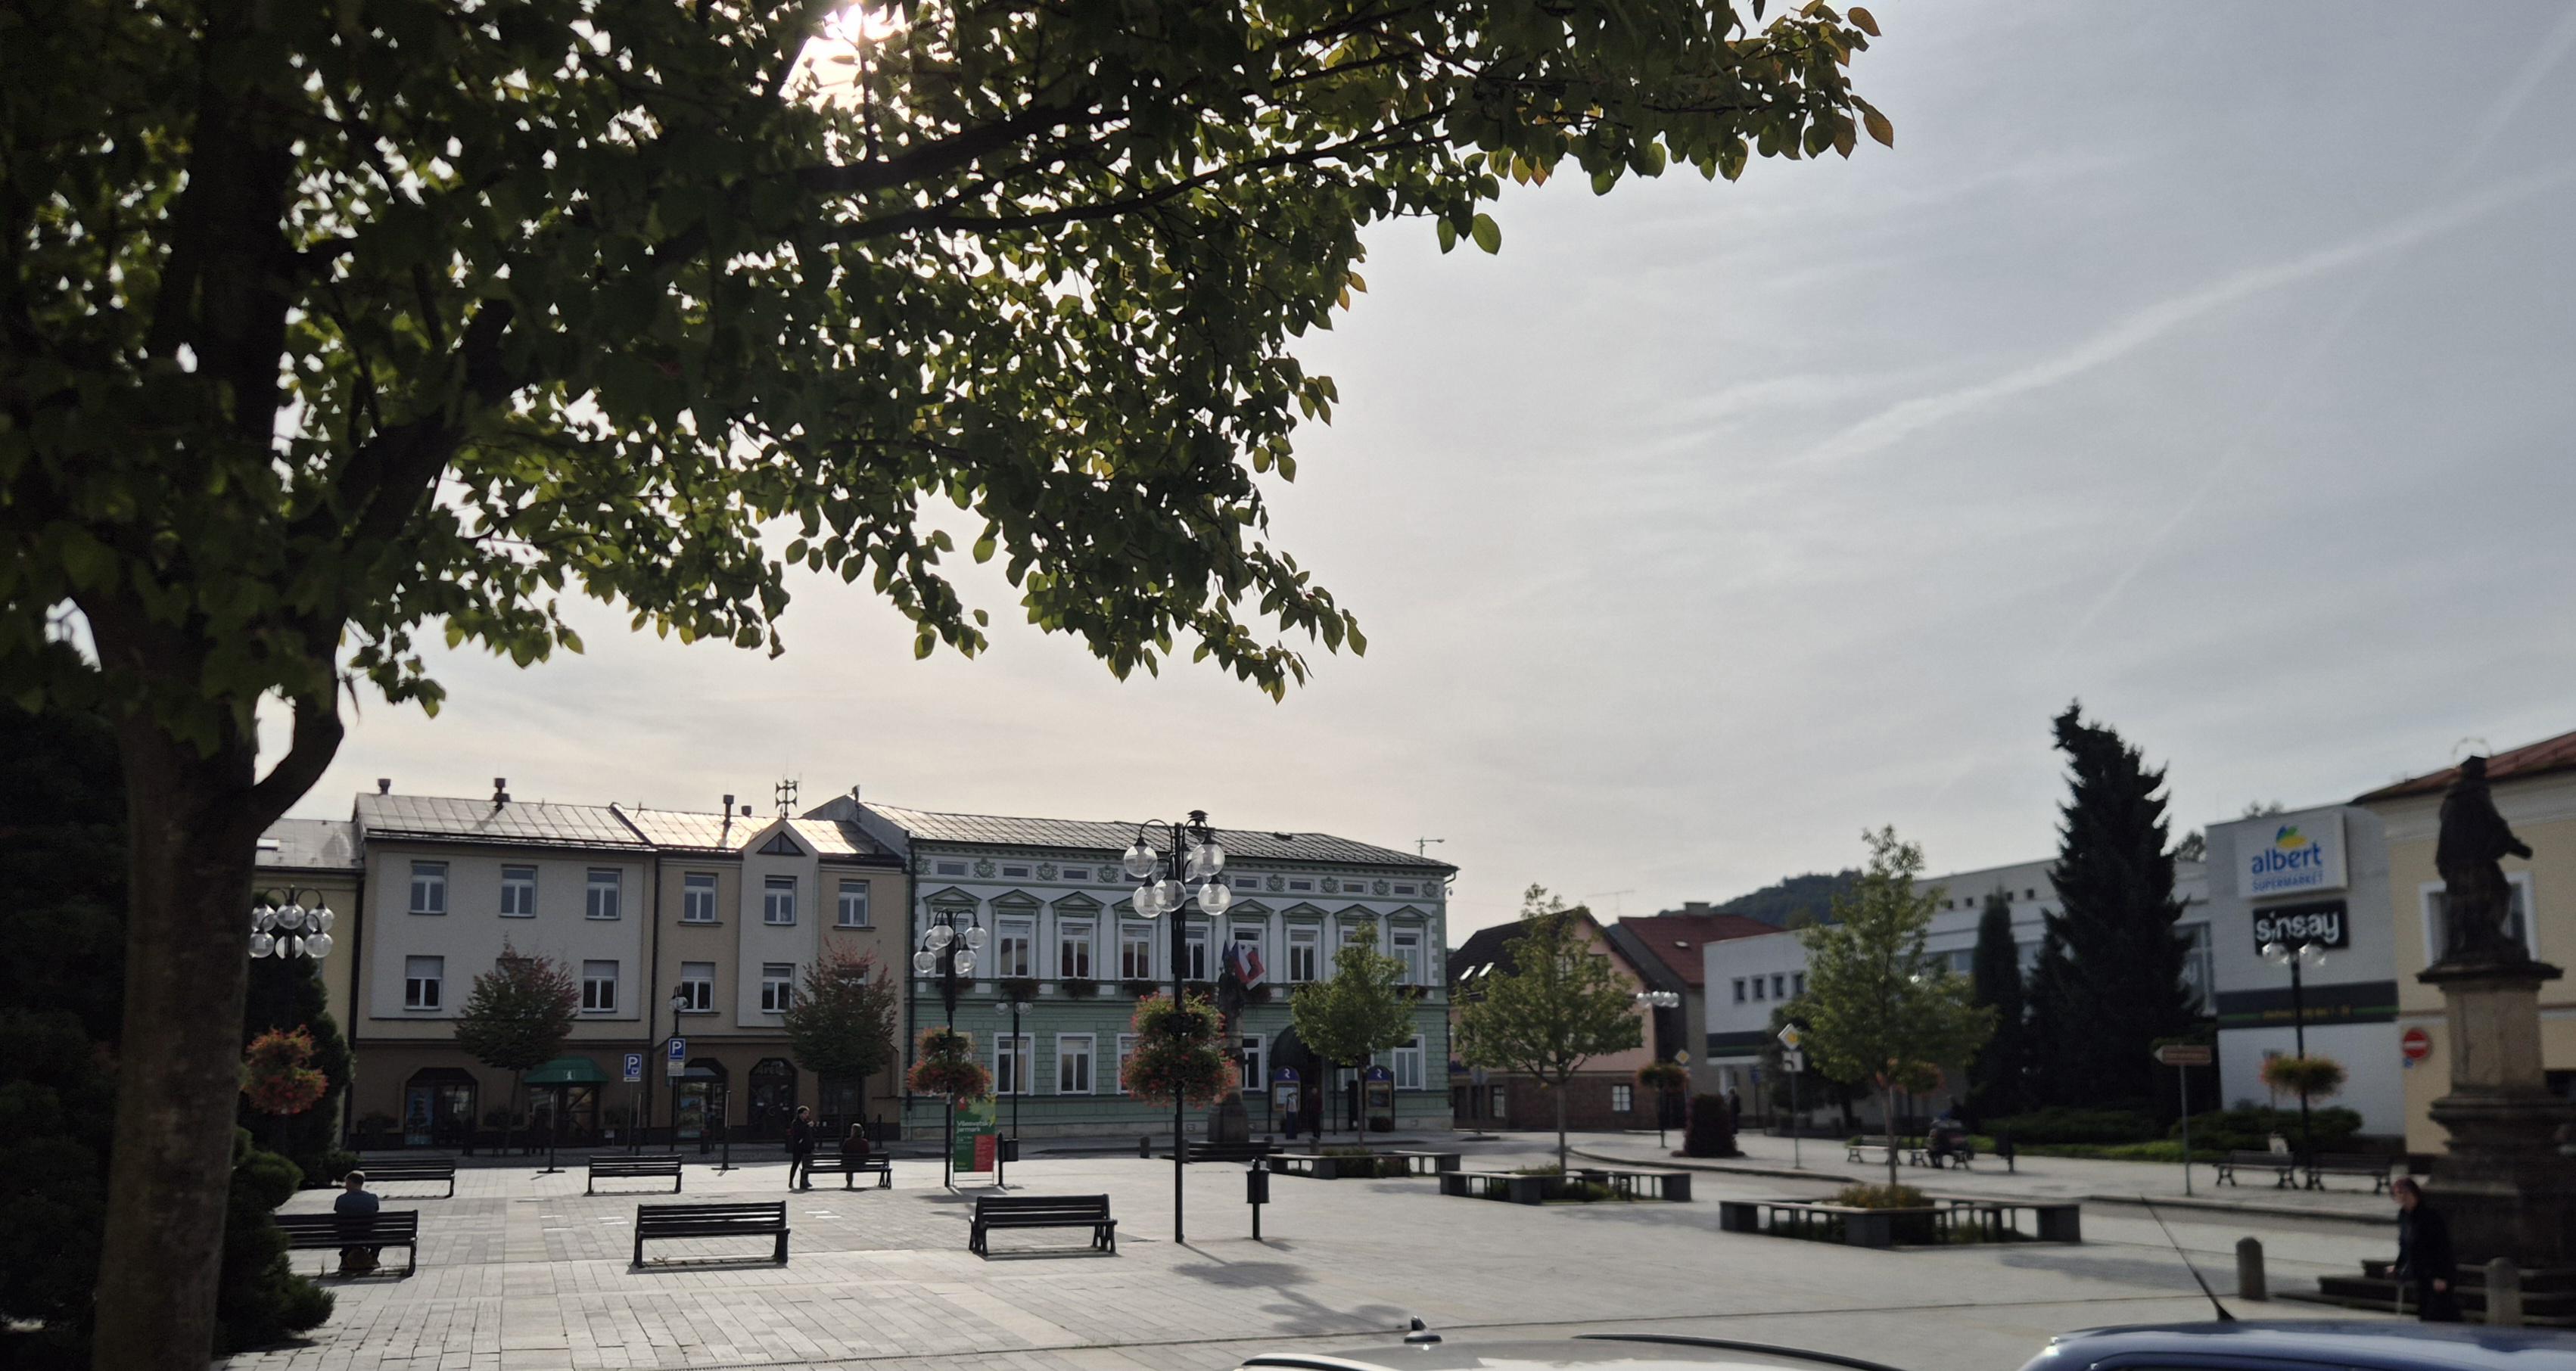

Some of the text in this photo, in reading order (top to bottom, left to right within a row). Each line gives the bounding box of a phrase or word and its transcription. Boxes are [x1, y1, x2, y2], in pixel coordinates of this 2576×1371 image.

[2252, 842, 2322, 875] albert
[2252, 872, 2323, 891] SUPERMARKET
[2256, 911, 2339, 944] sinsay
[671, 1040, 683, 1054] P
[627, 1056, 638, 1069] P
